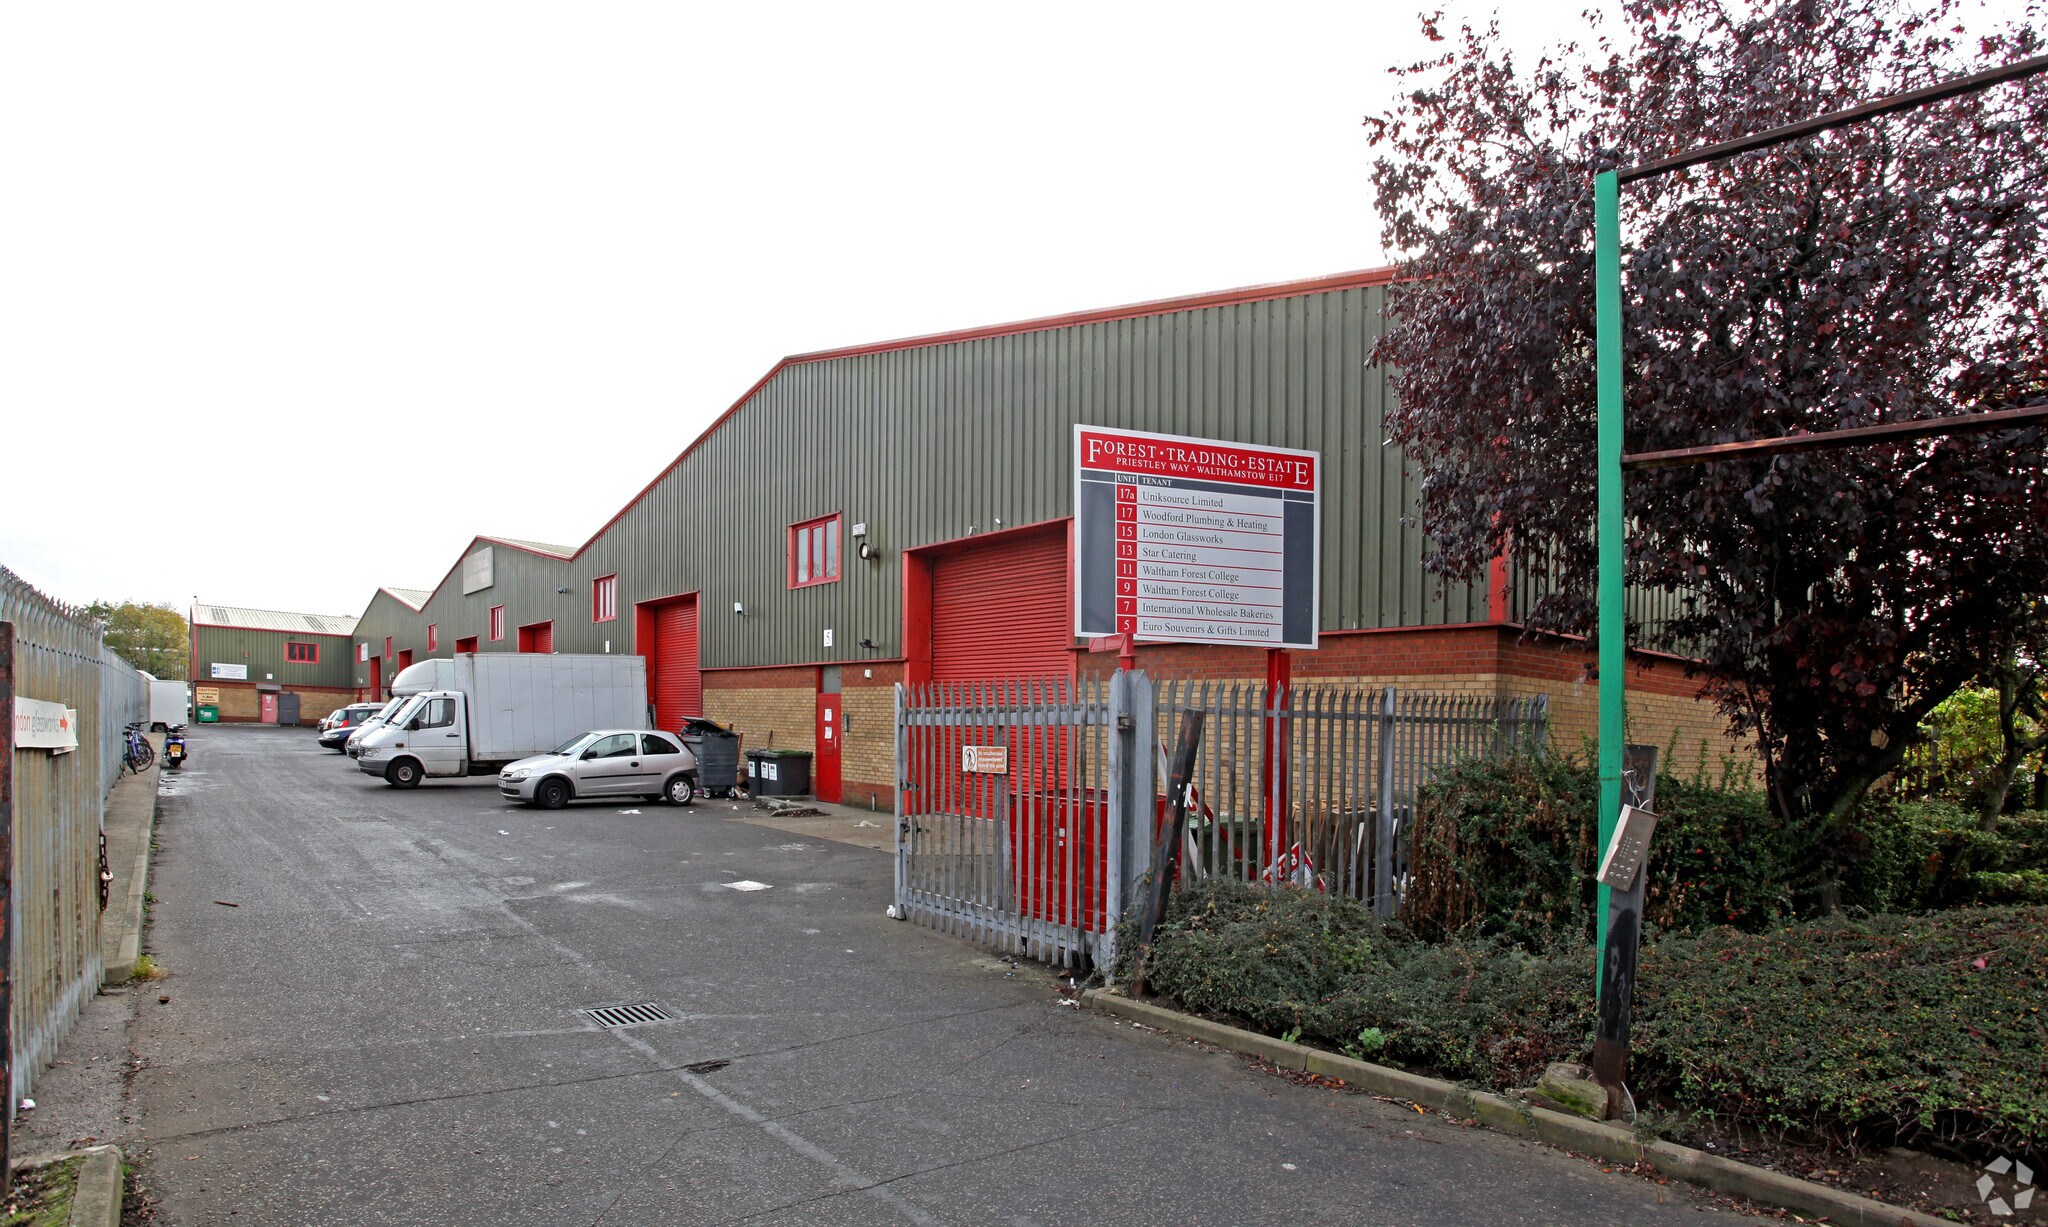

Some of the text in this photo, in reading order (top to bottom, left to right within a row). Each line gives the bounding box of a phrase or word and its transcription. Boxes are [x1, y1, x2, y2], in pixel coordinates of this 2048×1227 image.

[1087, 439, 1309, 485] FOREST TRADING ESTATE
[1116, 457, 1284, 482] PRIESTLEY WAY WALTHAMSTOW E17
[1117, 475, 1172, 486] UNIT TENANT
[1120, 488, 1223, 508] 17a Uniksource Limited
[1121, 507, 1268, 532] 17 Woodford Plumbing & Heating
[1121, 526, 1224, 544] 15 London Glassworks
[1121, 545, 1196, 562] 13 Star Catering
[1123, 563, 1239, 583] 11 Waltham Forest College
[1124, 582, 1239, 601] 9 Waltham Forest College
[1123, 601, 1274, 619] 7 International Wholesale Bakeries
[826, 631, 831, 645] 5
[1123, 620, 1270, 637] 5 Euro Souvenirs & Gifts Limited
[15, 707, 59, 738] ndon glassworks
